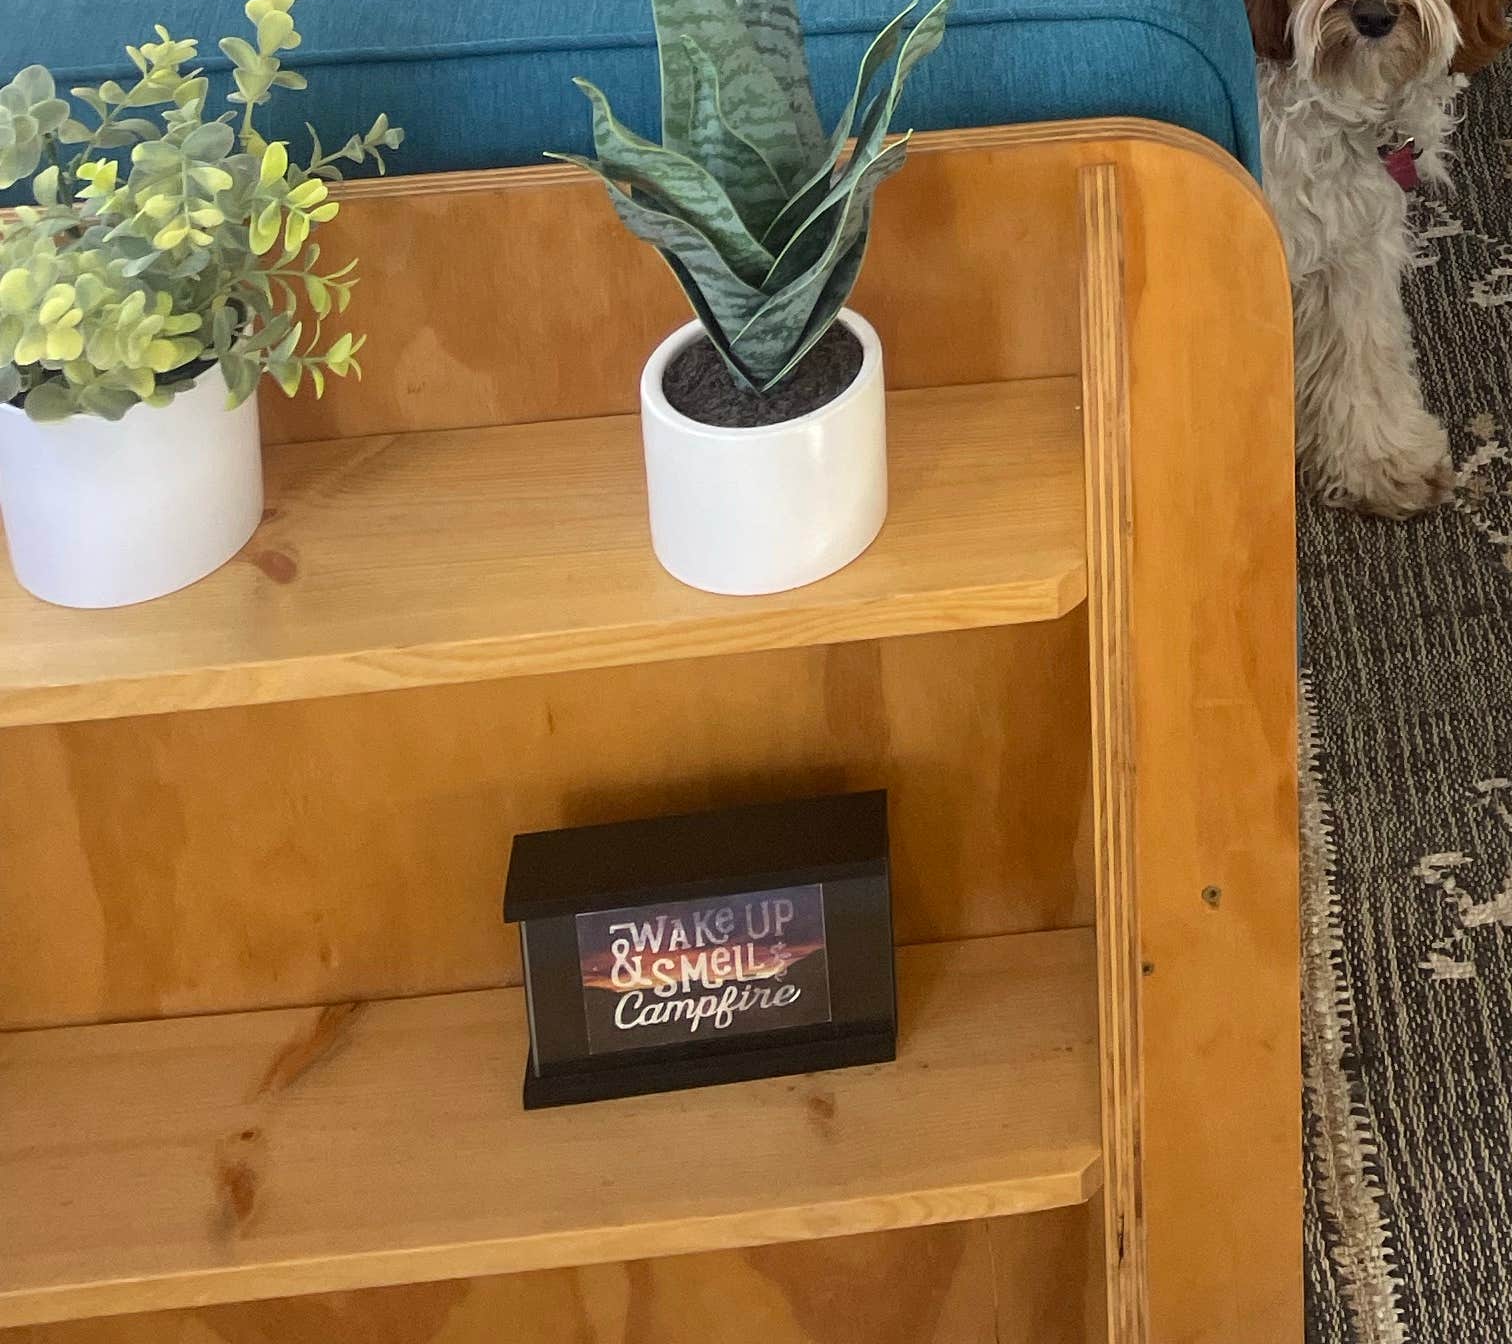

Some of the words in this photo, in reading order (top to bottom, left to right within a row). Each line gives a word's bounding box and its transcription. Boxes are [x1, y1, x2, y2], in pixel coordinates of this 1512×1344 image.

[745, 899, 795, 940] UP
[611, 938, 652, 988] &
[614, 983, 802, 1033] Campfire
